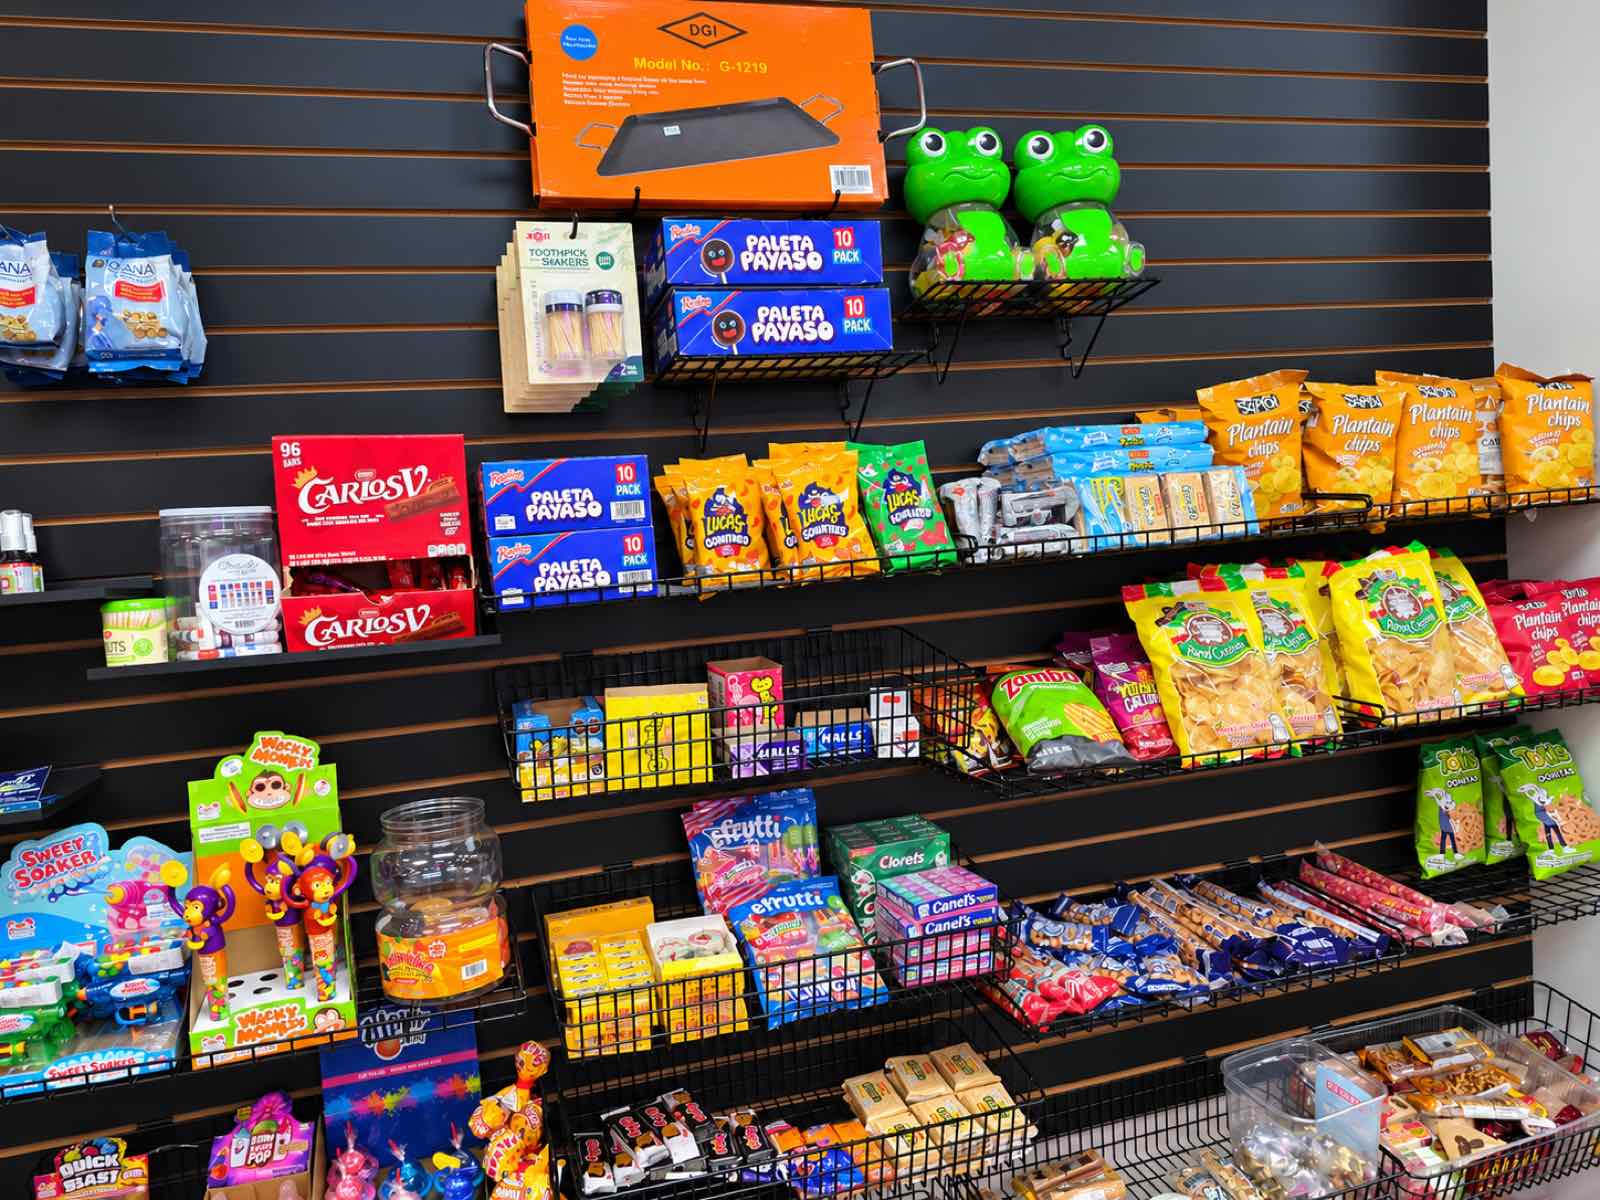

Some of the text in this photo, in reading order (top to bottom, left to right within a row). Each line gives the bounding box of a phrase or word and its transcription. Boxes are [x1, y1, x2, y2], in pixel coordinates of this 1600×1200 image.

[689, 23, 718, 37] DGI
[633, 56, 677, 71] Model
[719, 60, 768, 74] G-1219
[746, 234, 814, 252] PALETA
[835, 230, 852, 247] 10
[528, 248, 588, 258] TOOTHPICK
[740, 250, 823, 272] PAYASO
[833, 250, 861, 264] PACK
[756, 304, 825, 323] PALETA
[845, 299, 864, 317] 10
[751, 320, 834, 343] PAYASO
[844, 319, 872, 334] PACK
[1527, 393, 1592, 415] Plantain
[1409, 403, 1474, 425] Plantain
[1547, 411, 1582, 431] chips
[1227, 417, 1294, 448] Plantain
[1332, 414, 1395, 437] Plantain
[1430, 422, 1460, 440] chips
[280, 442, 301, 457] 96
[1248, 440, 1280, 459] chips
[1344, 437, 1381, 456] chips
[617, 465, 634, 481] 10
[530, 488, 594, 505] PALETA
[616, 484, 641, 496] PACK
[887, 488, 921, 513] LUCAS
[525, 500, 603, 522] PAYASO
[801, 503, 841, 527] LUCAS
[706, 513, 746, 534] LUCAS
[624, 536, 641, 552] 10
[538, 558, 603, 577] PALETA
[623, 554, 648, 566] PACK
[533, 571, 611, 593] PAYASO
[1512, 610, 1562, 631] Plantain
[1531, 626, 1559, 642] chips
[260, 736, 312, 756] WACKY
[822, 730, 863, 743] HALLS
[251, 747, 314, 770] MONKEY
[20, 836, 84, 868] SWEET
[879, 851, 925, 870] Clorets
[14, 850, 97, 888] SOAKER
[751, 890, 824, 916] efrutti
[932, 893, 976, 915] Canel's
[924, 914, 972, 936] Canel's
[237, 1004, 300, 1030] WACKY
[59, 1153, 120, 1179] QUICK
[248, 1150, 273, 1164] POP
